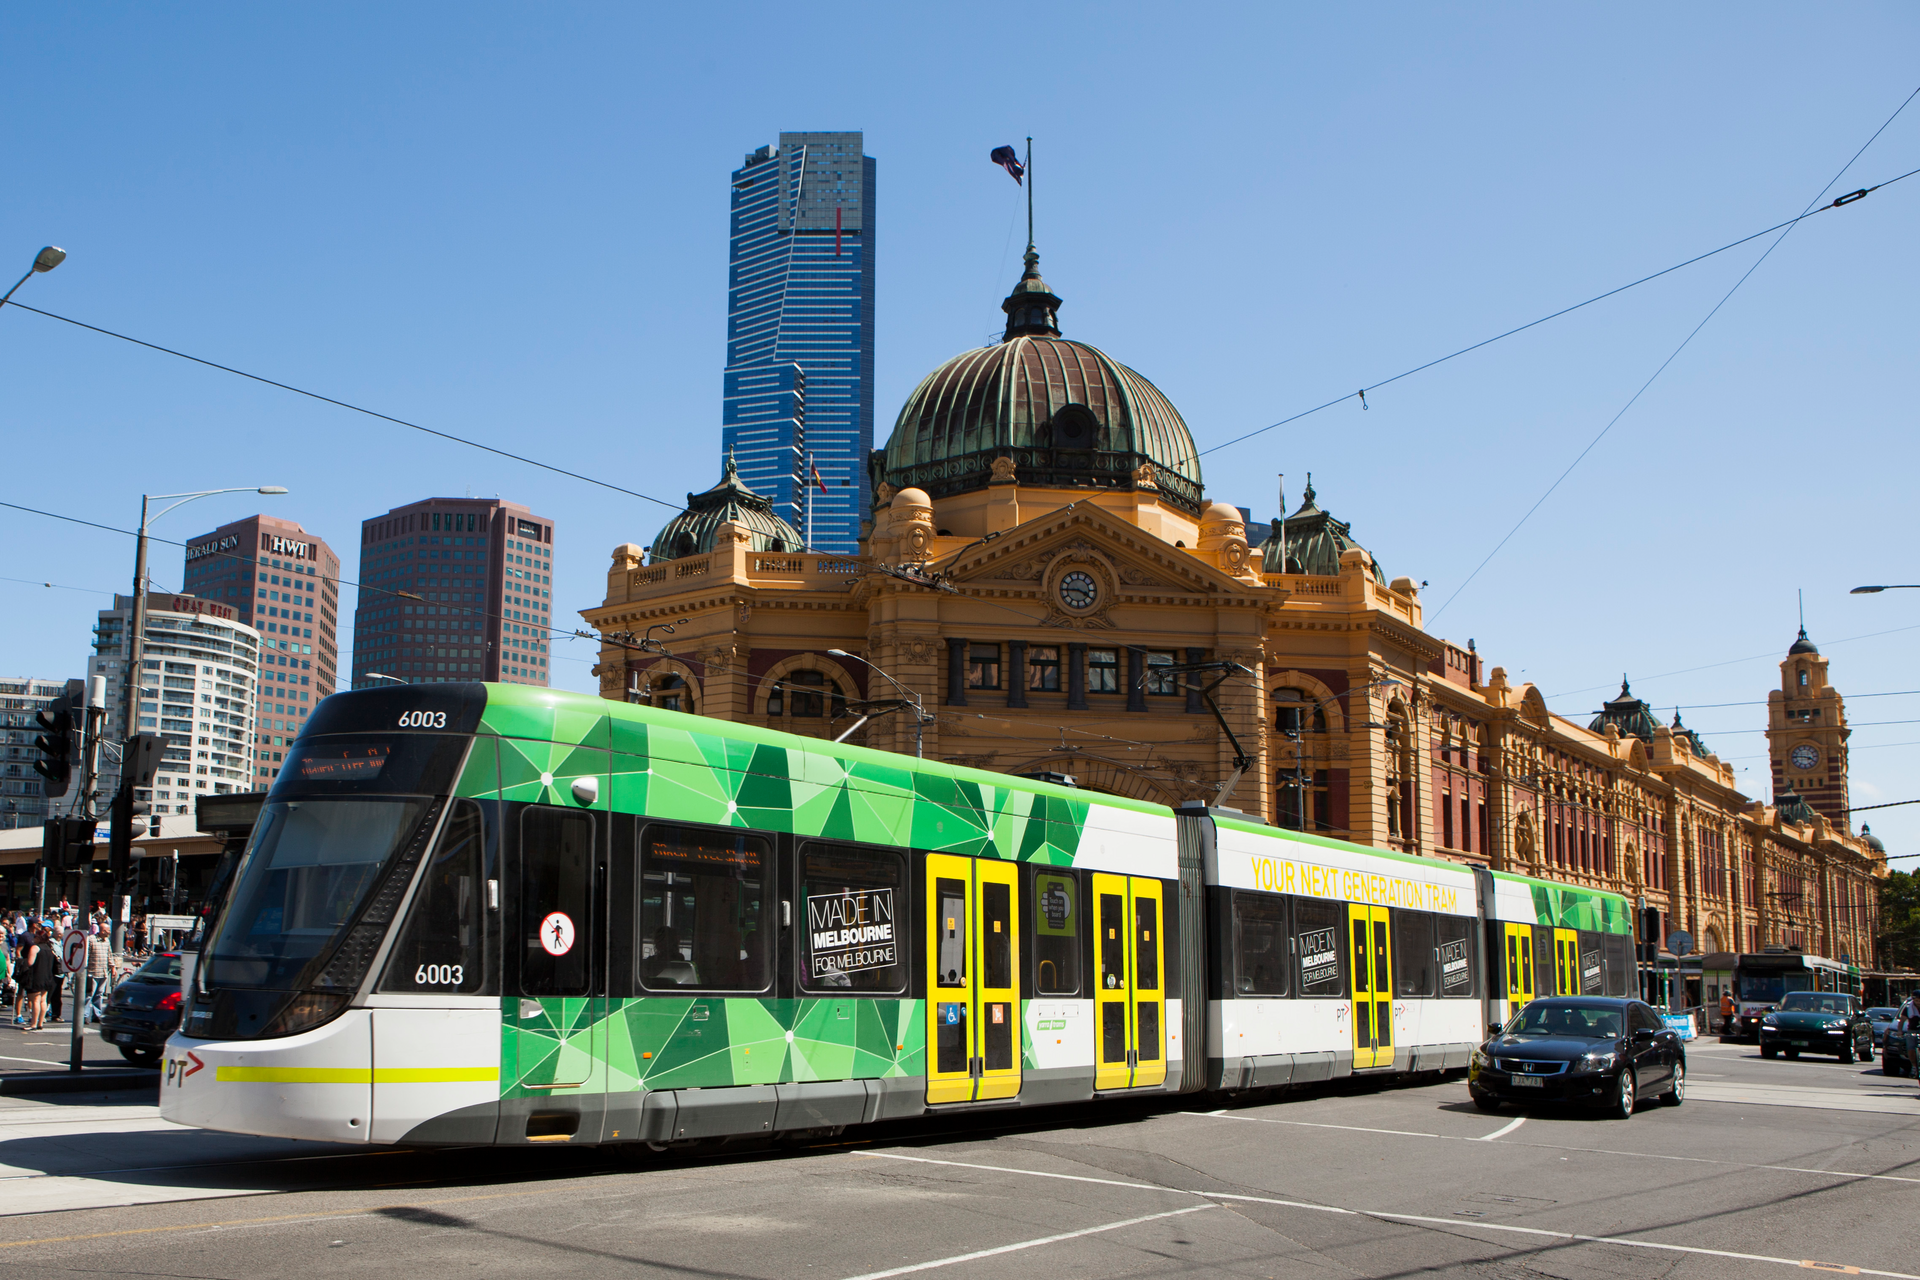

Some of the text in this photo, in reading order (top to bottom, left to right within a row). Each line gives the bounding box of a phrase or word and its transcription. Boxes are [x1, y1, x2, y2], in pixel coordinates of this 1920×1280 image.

[220, 534, 239, 551] SUN
[273, 535, 307, 557] HWT
[173, 597, 232, 619] QUAY WEST
[398, 710, 447, 729] 6003
[1251, 856, 1457, 913] YOUR NEXT GENERATION TRAM
[811, 893, 892, 930] MADE IN
[813, 923, 893, 949] MELBOURNE
[1300, 932, 1326, 956] MADE
[815, 947, 894, 973] FOR MELBOURNE
[1302, 950, 1336, 968] MELBOURNE
[414, 964, 464, 985] 6003
